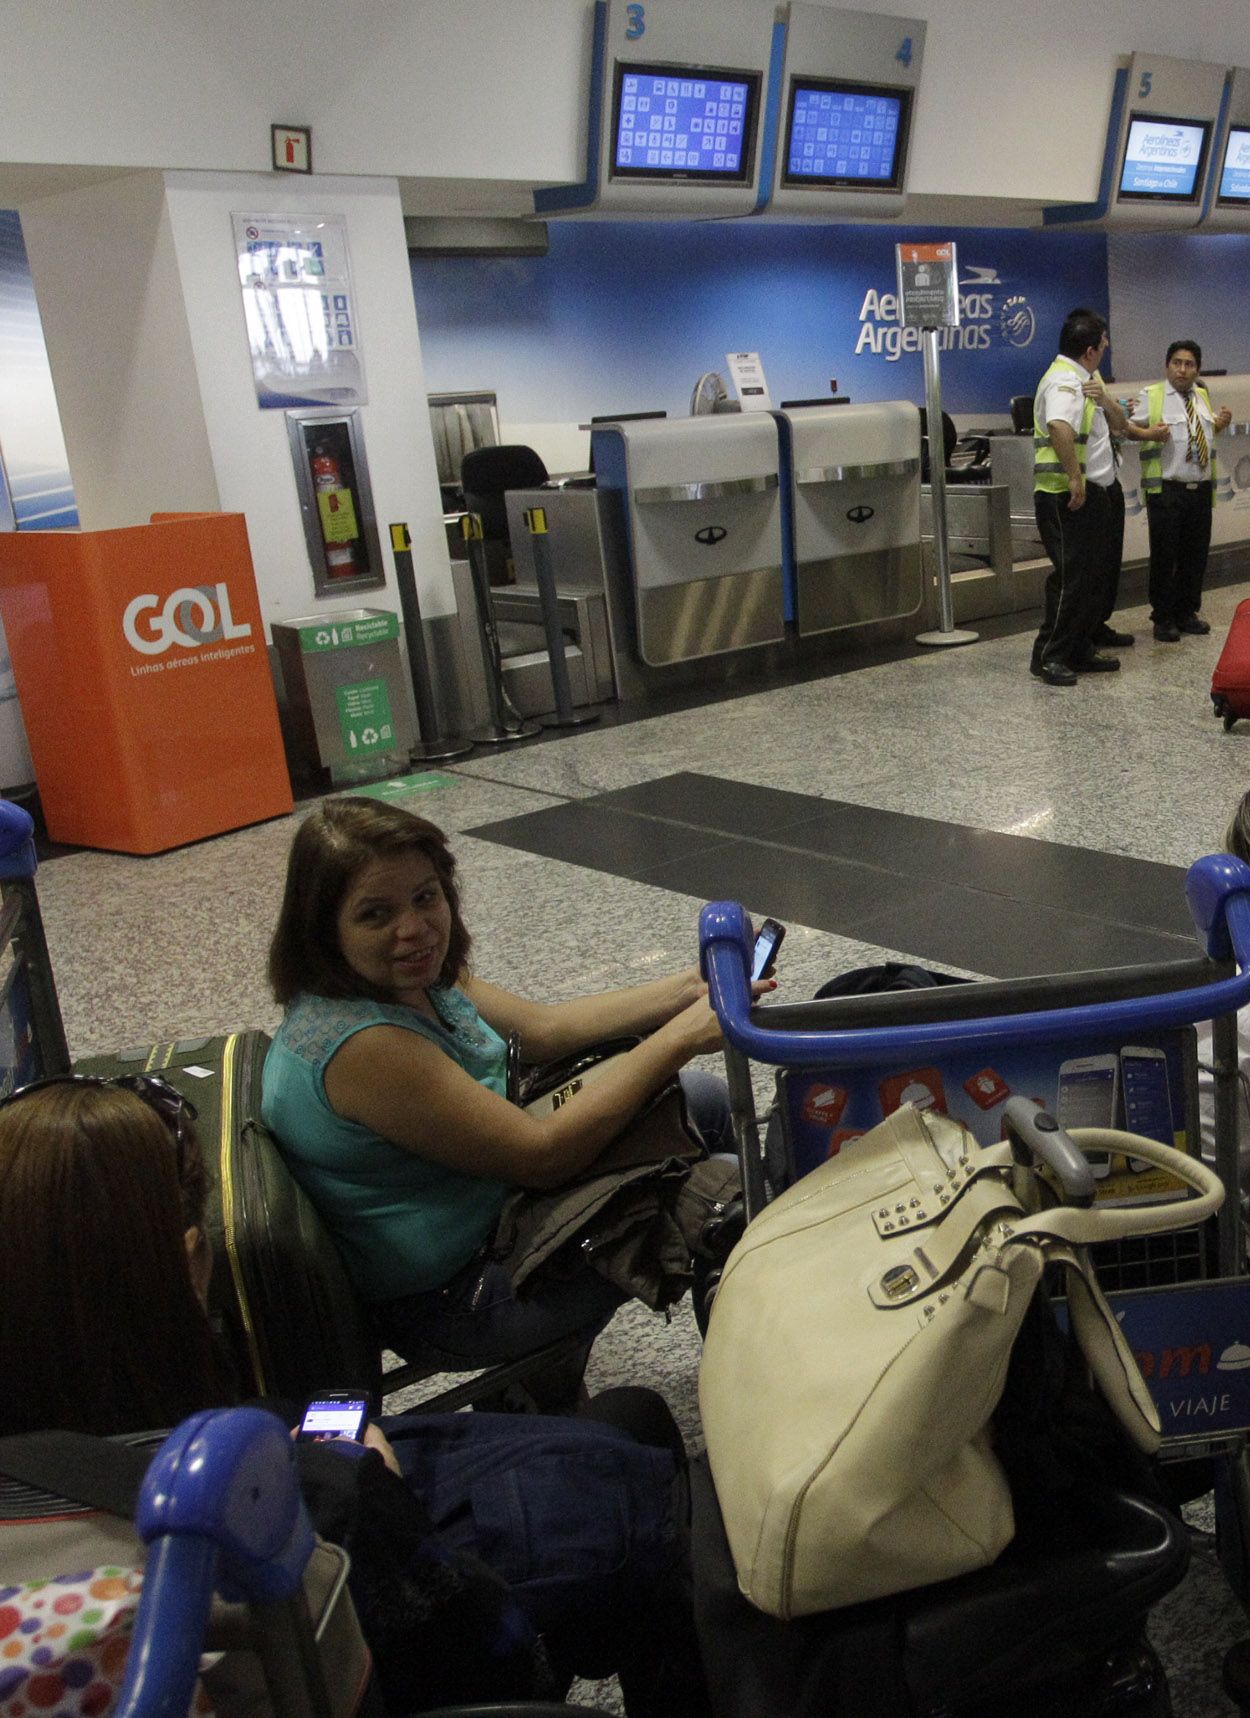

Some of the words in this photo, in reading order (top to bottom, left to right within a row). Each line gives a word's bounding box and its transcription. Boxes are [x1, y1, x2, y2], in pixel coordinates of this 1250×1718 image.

[626, 4, 646, 40] 3
[896, 37, 913, 68] 4
[1138, 71, 1153, 98] 5
[123, 582, 252, 656] GOL
[130, 661, 165, 677] Linhas
[166, 655, 199, 671] aéreas
[201, 644, 256, 661] inteligentes
[1170, 1394, 1232, 1417] VIAJE
